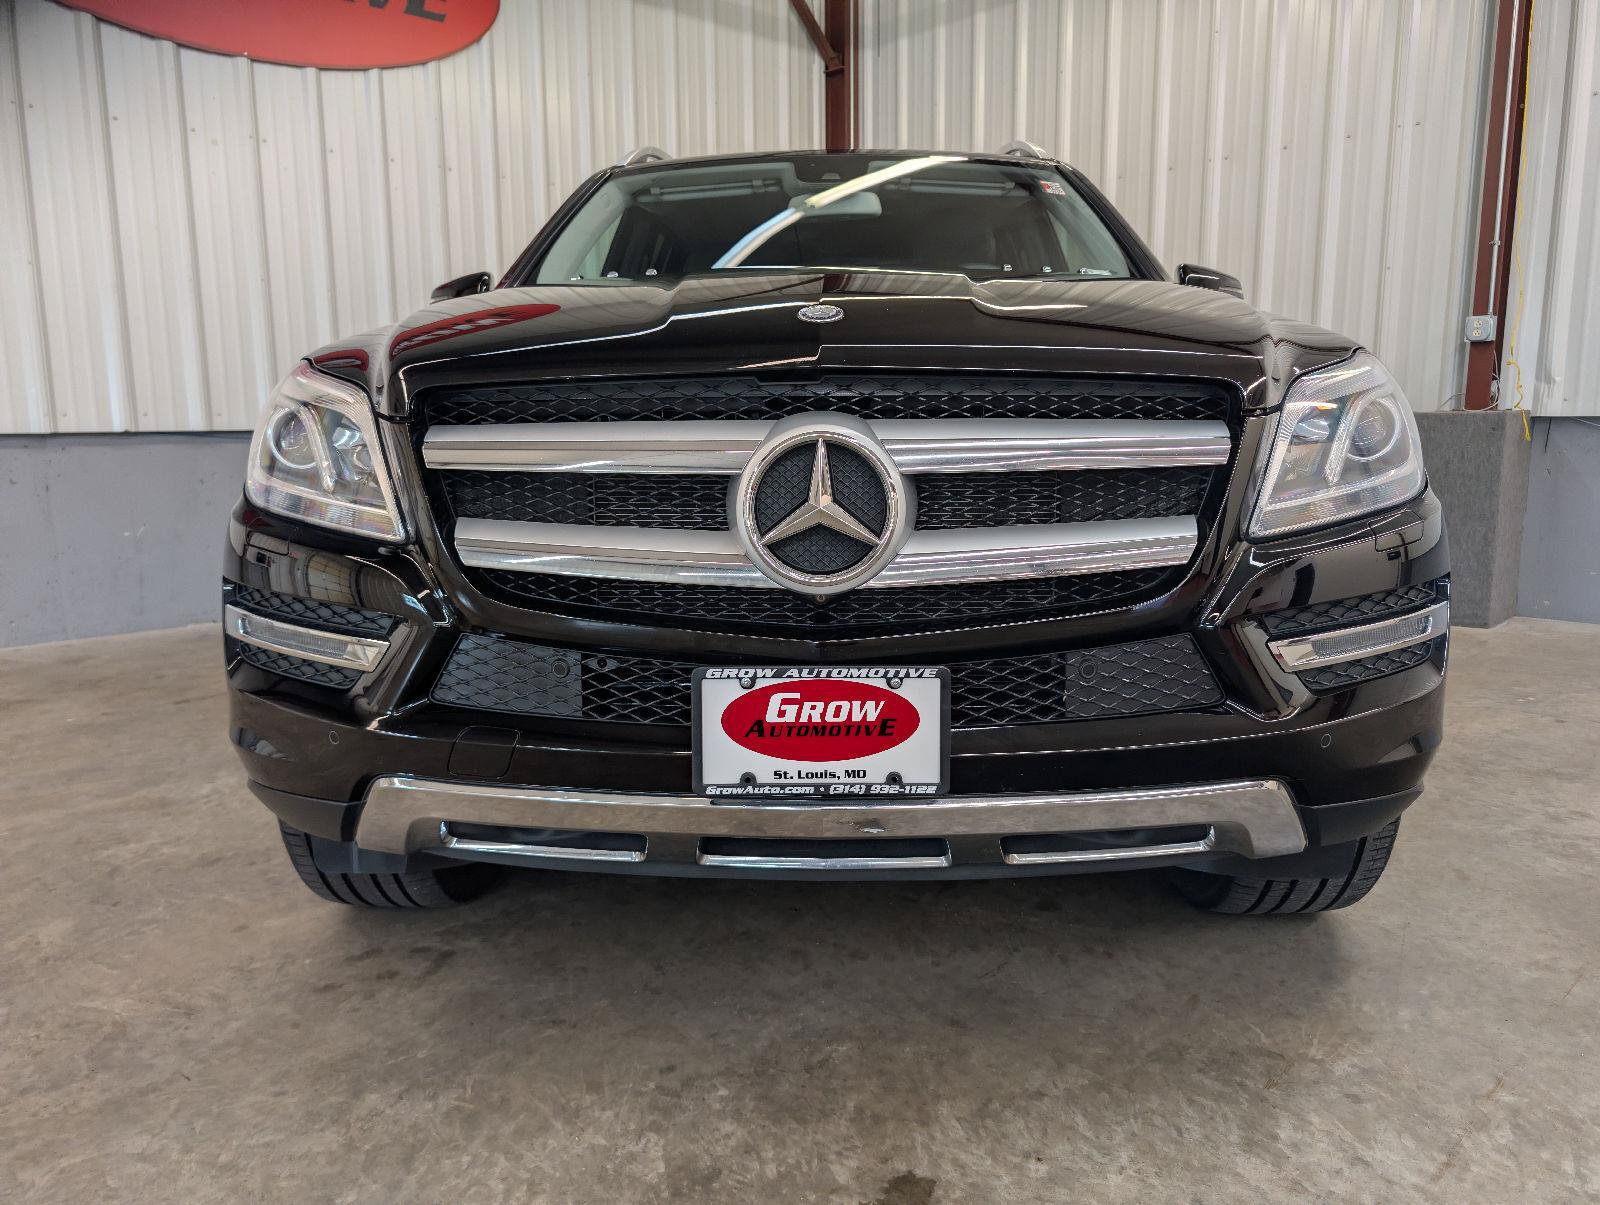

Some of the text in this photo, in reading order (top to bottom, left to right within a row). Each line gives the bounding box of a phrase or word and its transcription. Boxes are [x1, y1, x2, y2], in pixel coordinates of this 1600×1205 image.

[705, 668, 938, 678] GROW AUTOMOTIVE
[765, 692, 885, 723] GROW
[744, 718, 896, 738] AUTOMOTIVE
[773, 770, 794, 779] St.
[798, 770, 841, 780] Louis,
[705, 784, 938, 795] GrowAuto.com (314) 932-1122
